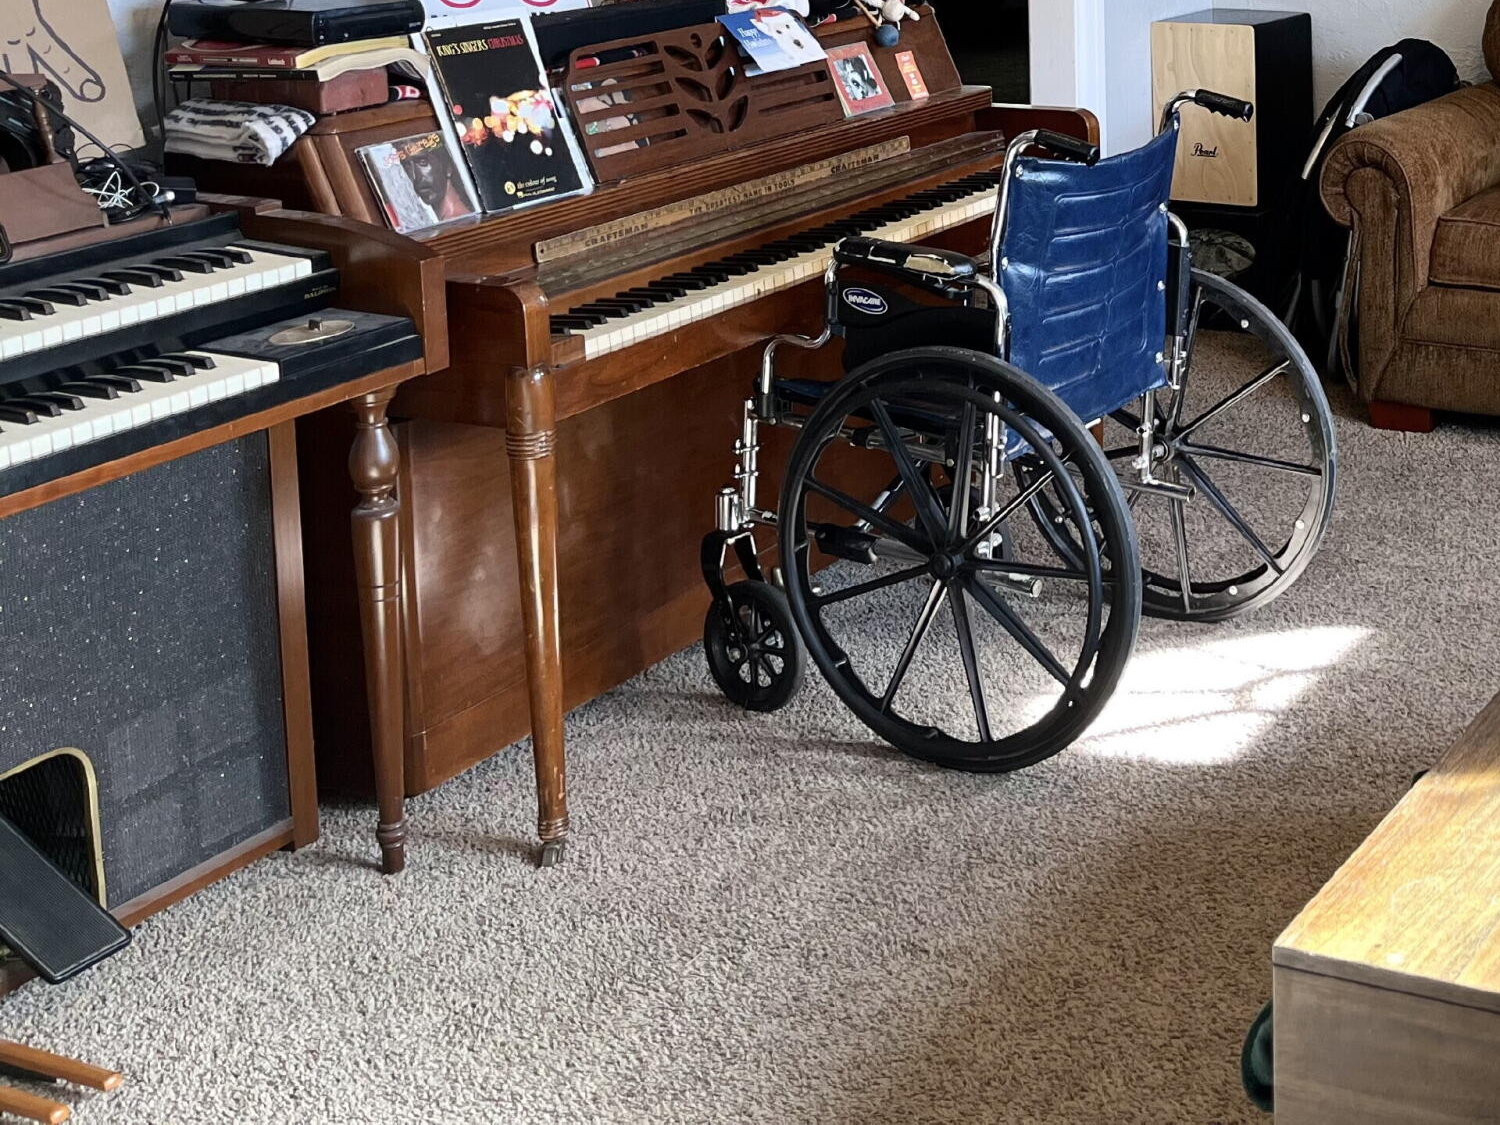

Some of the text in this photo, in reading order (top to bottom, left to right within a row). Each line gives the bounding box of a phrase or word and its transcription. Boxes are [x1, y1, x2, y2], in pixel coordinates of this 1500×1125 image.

[460, 39, 488, 54] SINGERS
[585, 223, 649, 247] CRAFTSMAN
[774, 178, 795, 191] TOOLS
[831, 154, 880, 174] CRAFTSMAN
